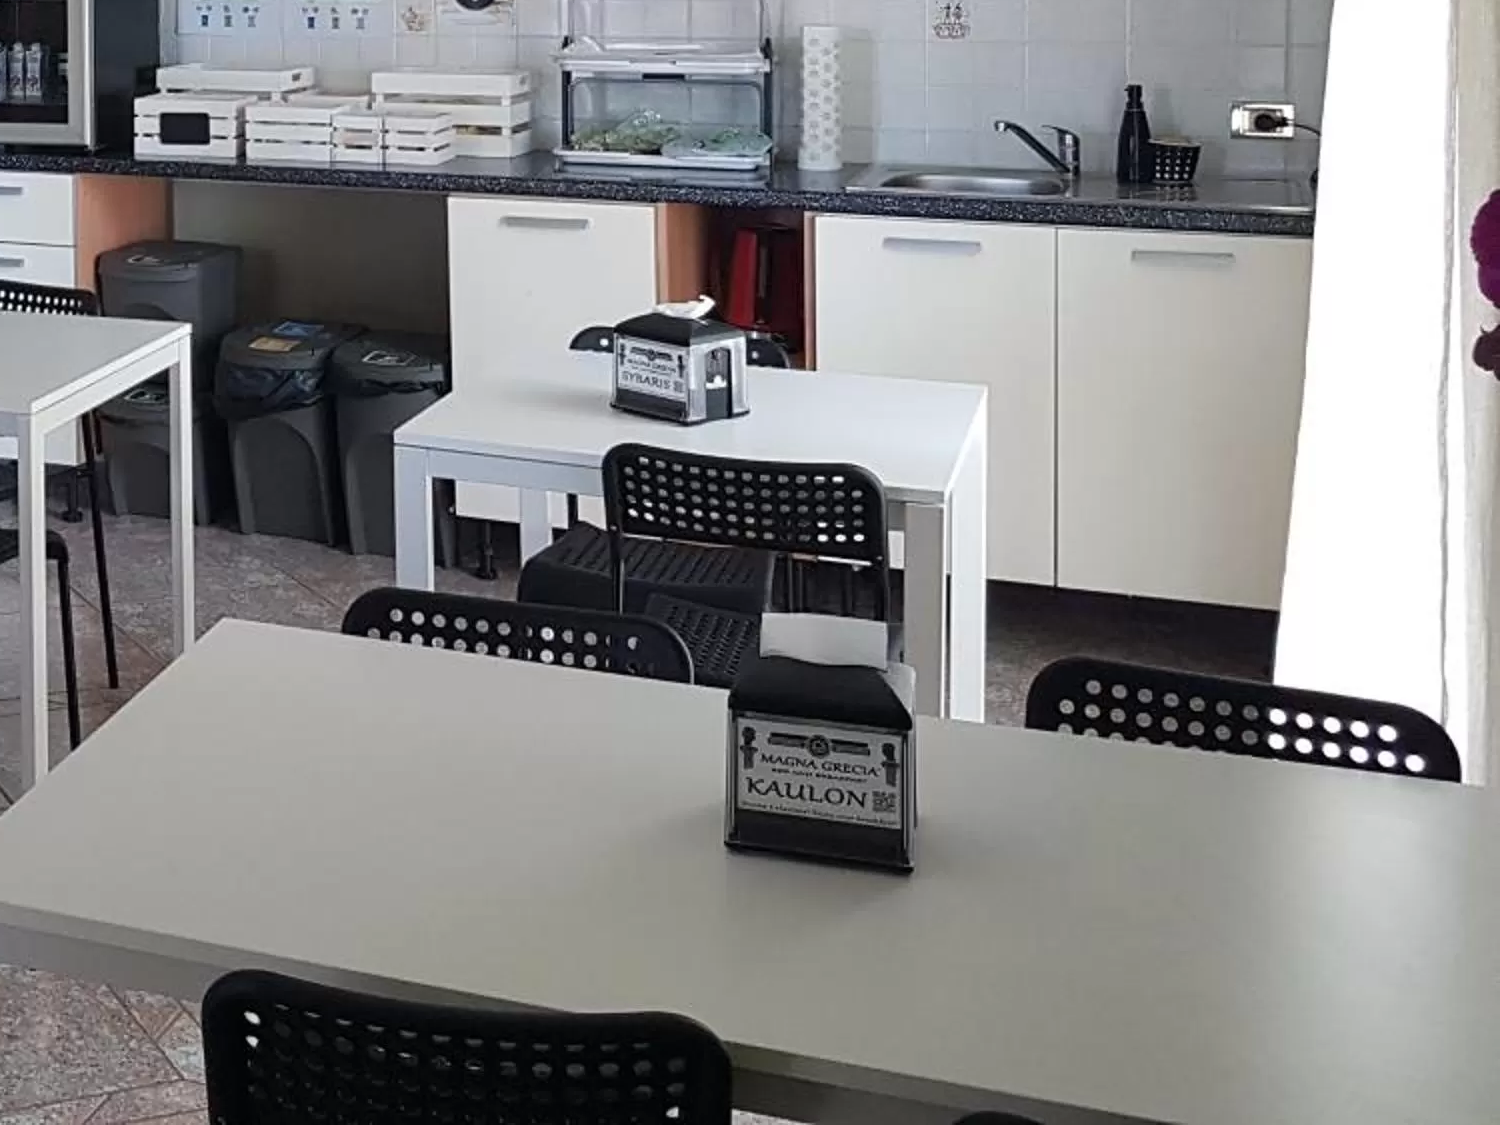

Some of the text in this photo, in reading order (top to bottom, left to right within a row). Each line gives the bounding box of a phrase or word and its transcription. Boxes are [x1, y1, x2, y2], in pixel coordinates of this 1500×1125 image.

[760, 753, 817, 771] MAGNA
[821, 761, 880, 778] GRECIA
[745, 776, 869, 809] KAULON
